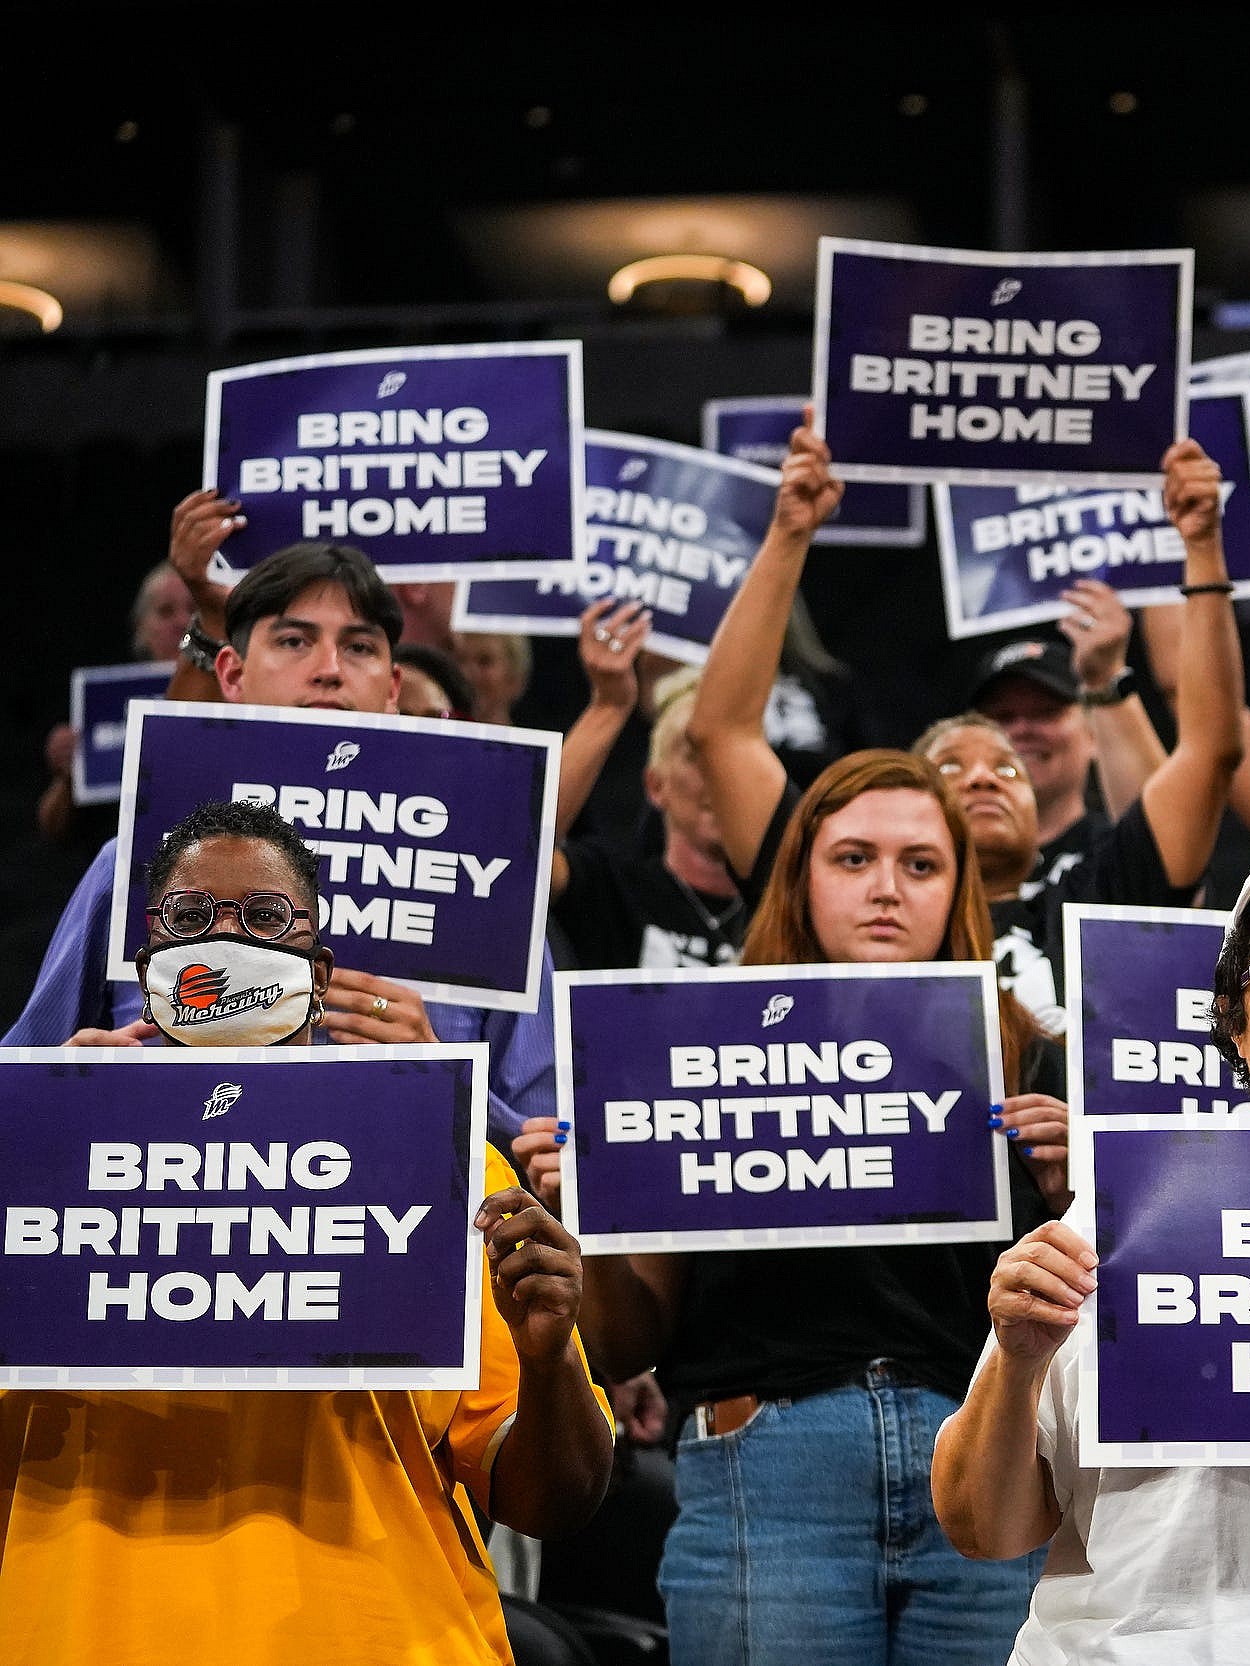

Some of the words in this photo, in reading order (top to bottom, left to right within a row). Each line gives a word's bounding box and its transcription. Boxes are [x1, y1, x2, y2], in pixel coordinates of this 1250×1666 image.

[910, 314, 1101, 356] BRING
[851, 354, 1156, 401] BRITTNEY
[297, 406, 489, 448] BRING
[911, 404, 1093, 444] HOME
[239, 449, 548, 494] BRITTNEY
[302, 495, 487, 537] HOME
[586, 485, 708, 540] RING
[972, 480, 1236, 554] BRITTN
[1027, 527, 1187, 583] HOME
[318, 894, 436, 945] ME
[177, 985, 283, 1023] Mercury
[669, 1040, 893, 1088] BRING
[604, 1090, 962, 1143] BRITTNEY
[87, 1140, 352, 1191] BRING
[680, 1146, 894, 1195] HOME
[4, 1205, 433, 1256] BRITTNEY
[87, 1271, 341, 1321] HOME
